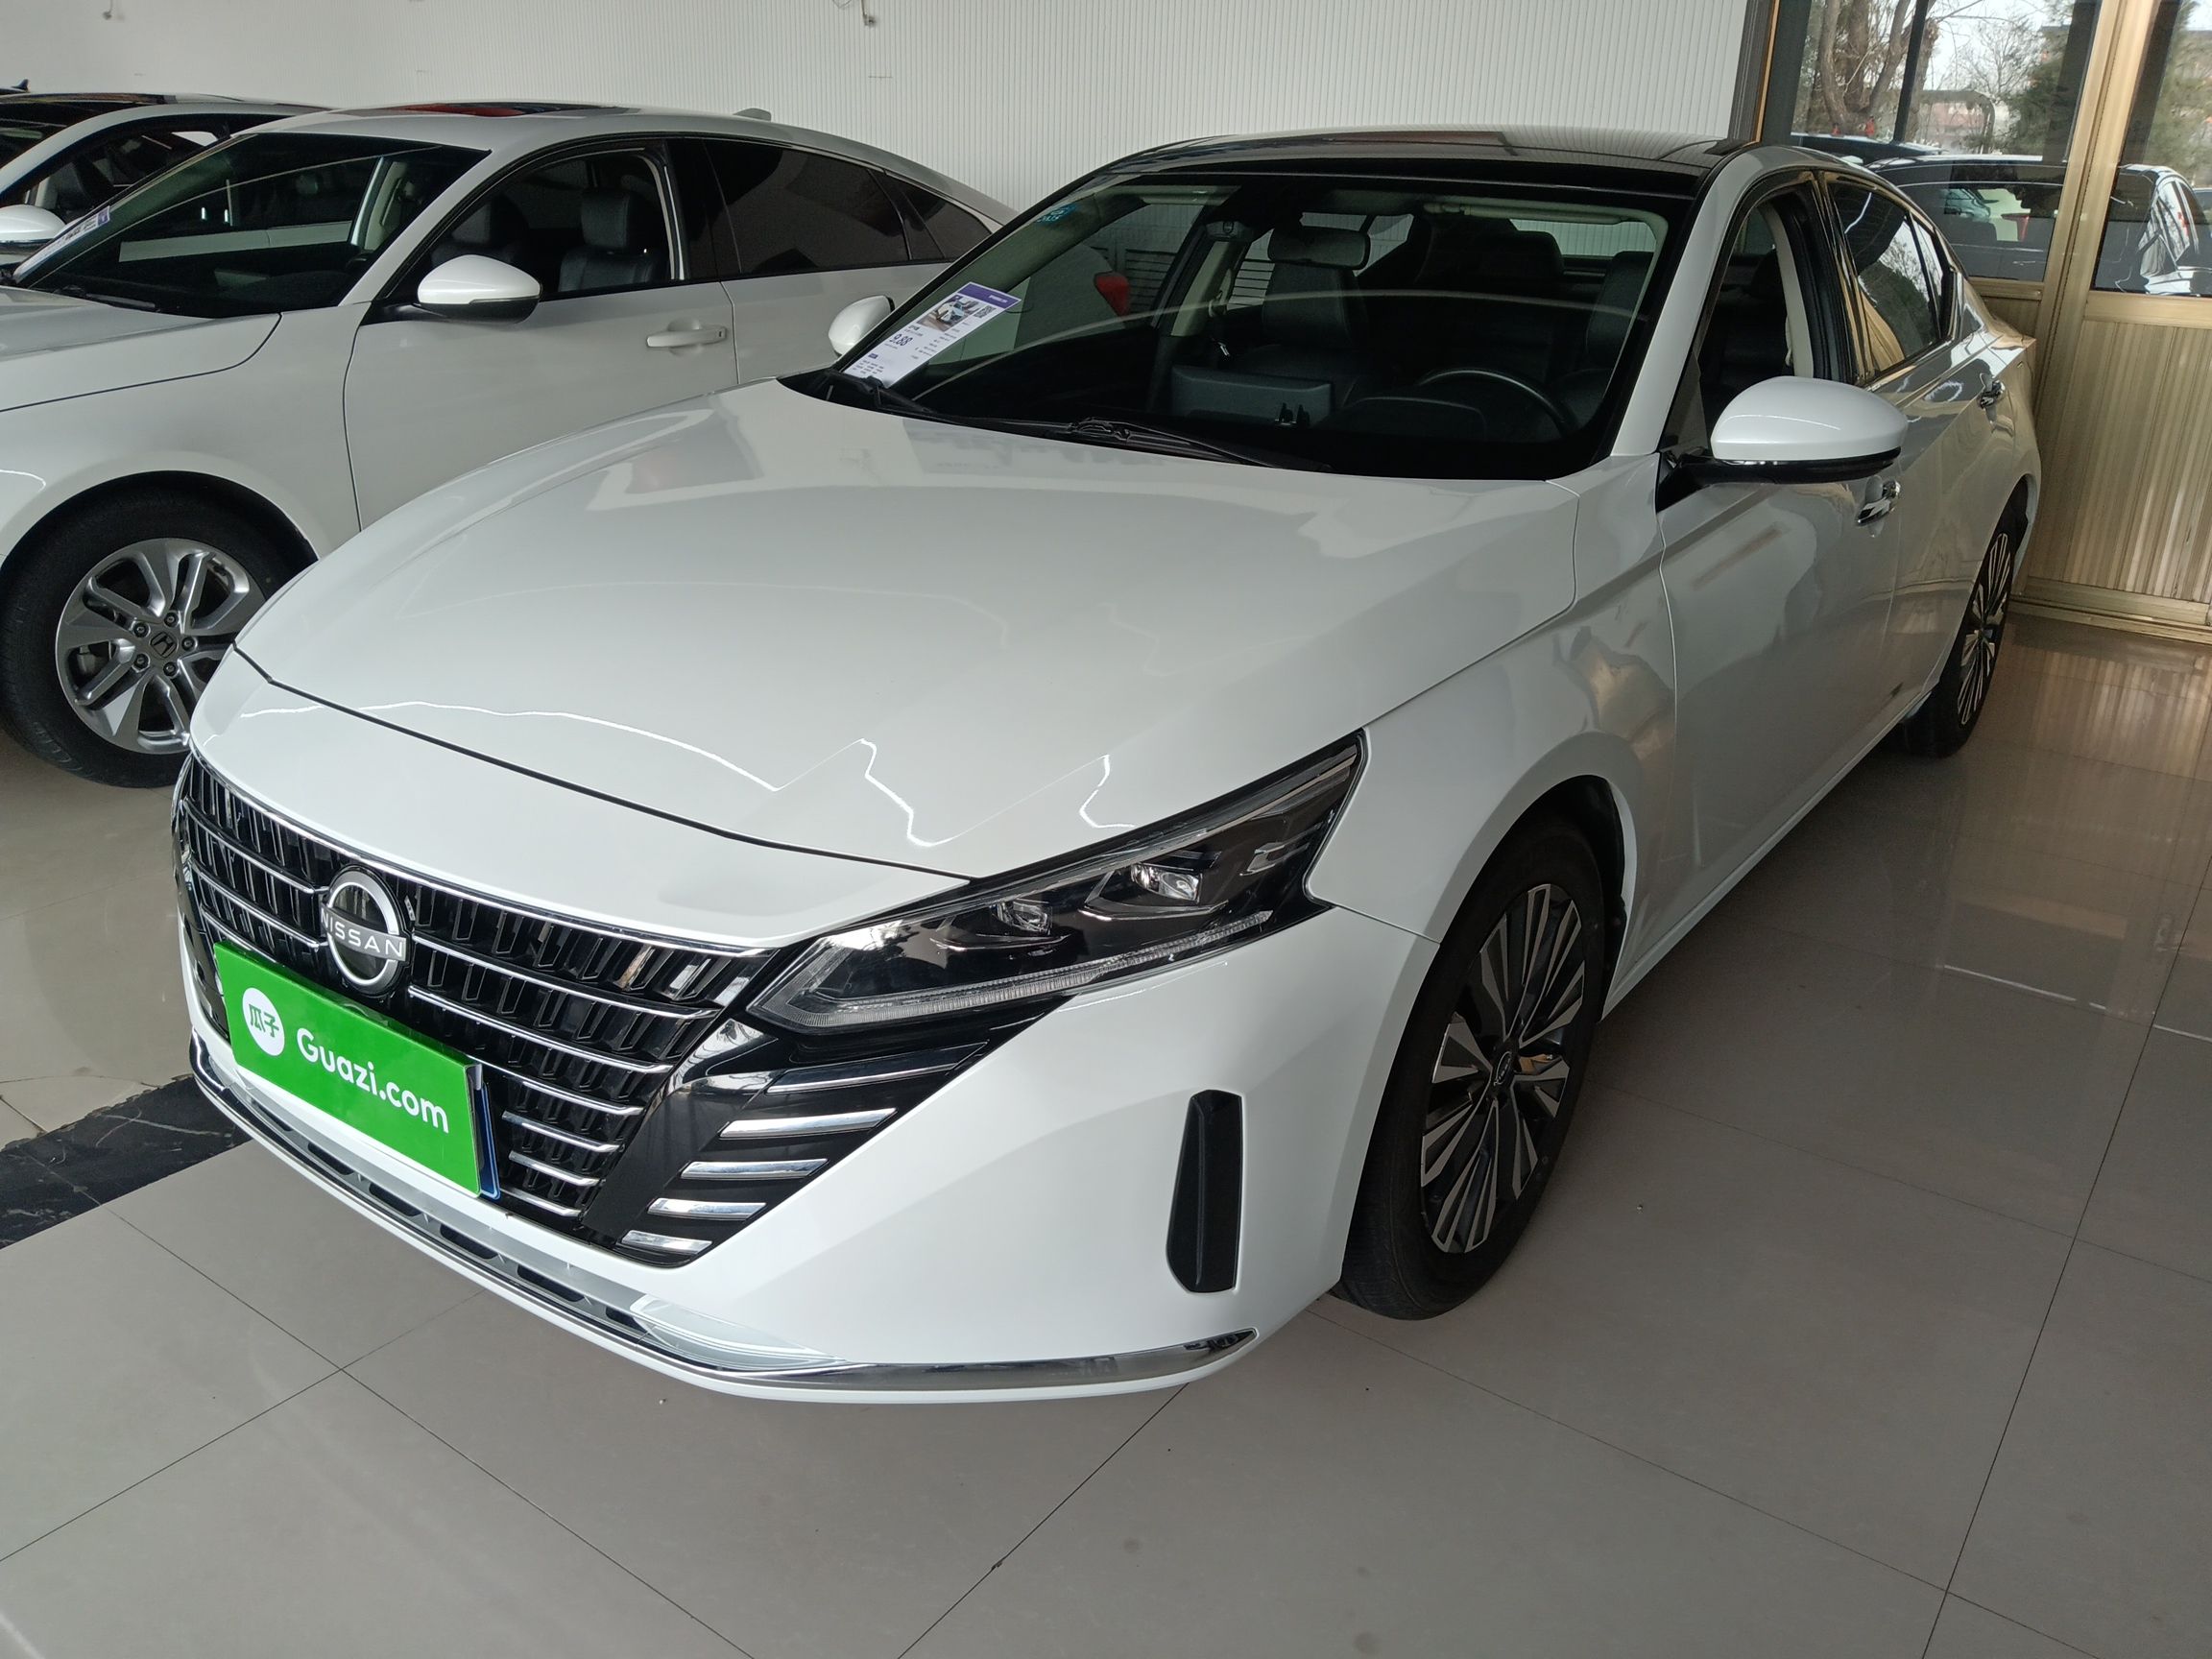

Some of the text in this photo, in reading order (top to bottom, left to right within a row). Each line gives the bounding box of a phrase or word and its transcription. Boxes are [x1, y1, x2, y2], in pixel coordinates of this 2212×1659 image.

[321, 907, 403, 957] NISSAN
[249, 1003, 279, 1038] 瓜子
[297, 1027, 449, 1134] Guazi.com
